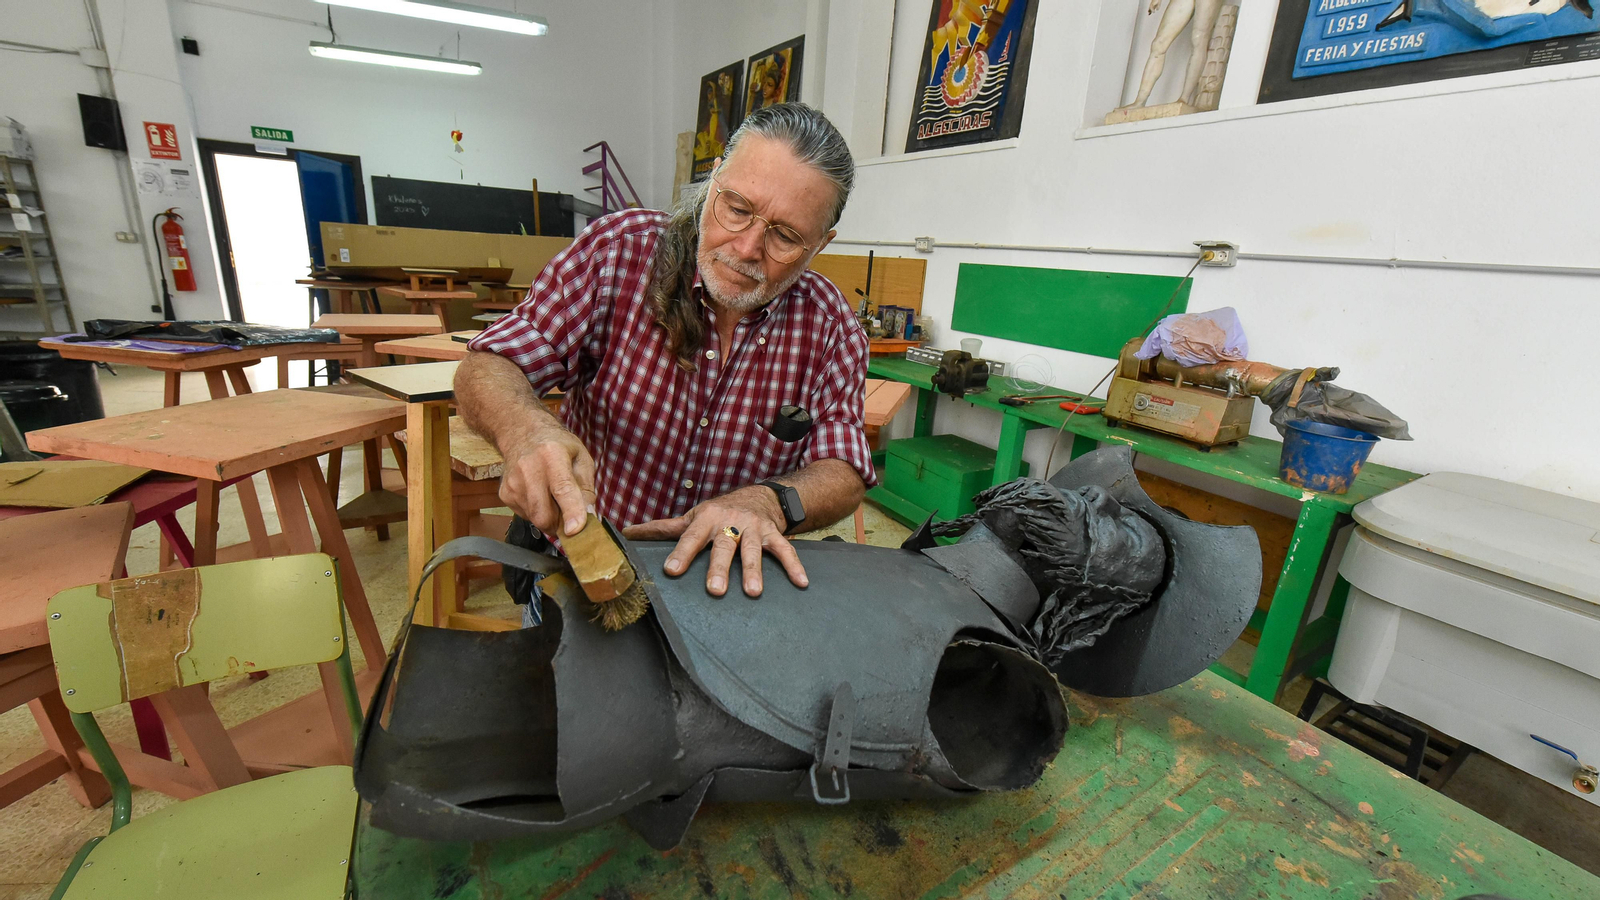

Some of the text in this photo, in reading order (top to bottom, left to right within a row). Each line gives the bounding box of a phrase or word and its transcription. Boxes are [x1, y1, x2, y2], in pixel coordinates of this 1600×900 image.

[1327, 13, 1368, 34] 1.959
[1305, 32, 1425, 62] FERIA Y FIESTAS
[254, 128, 289, 140] SALIDA
[917, 111, 992, 140] ALGECIRAS
